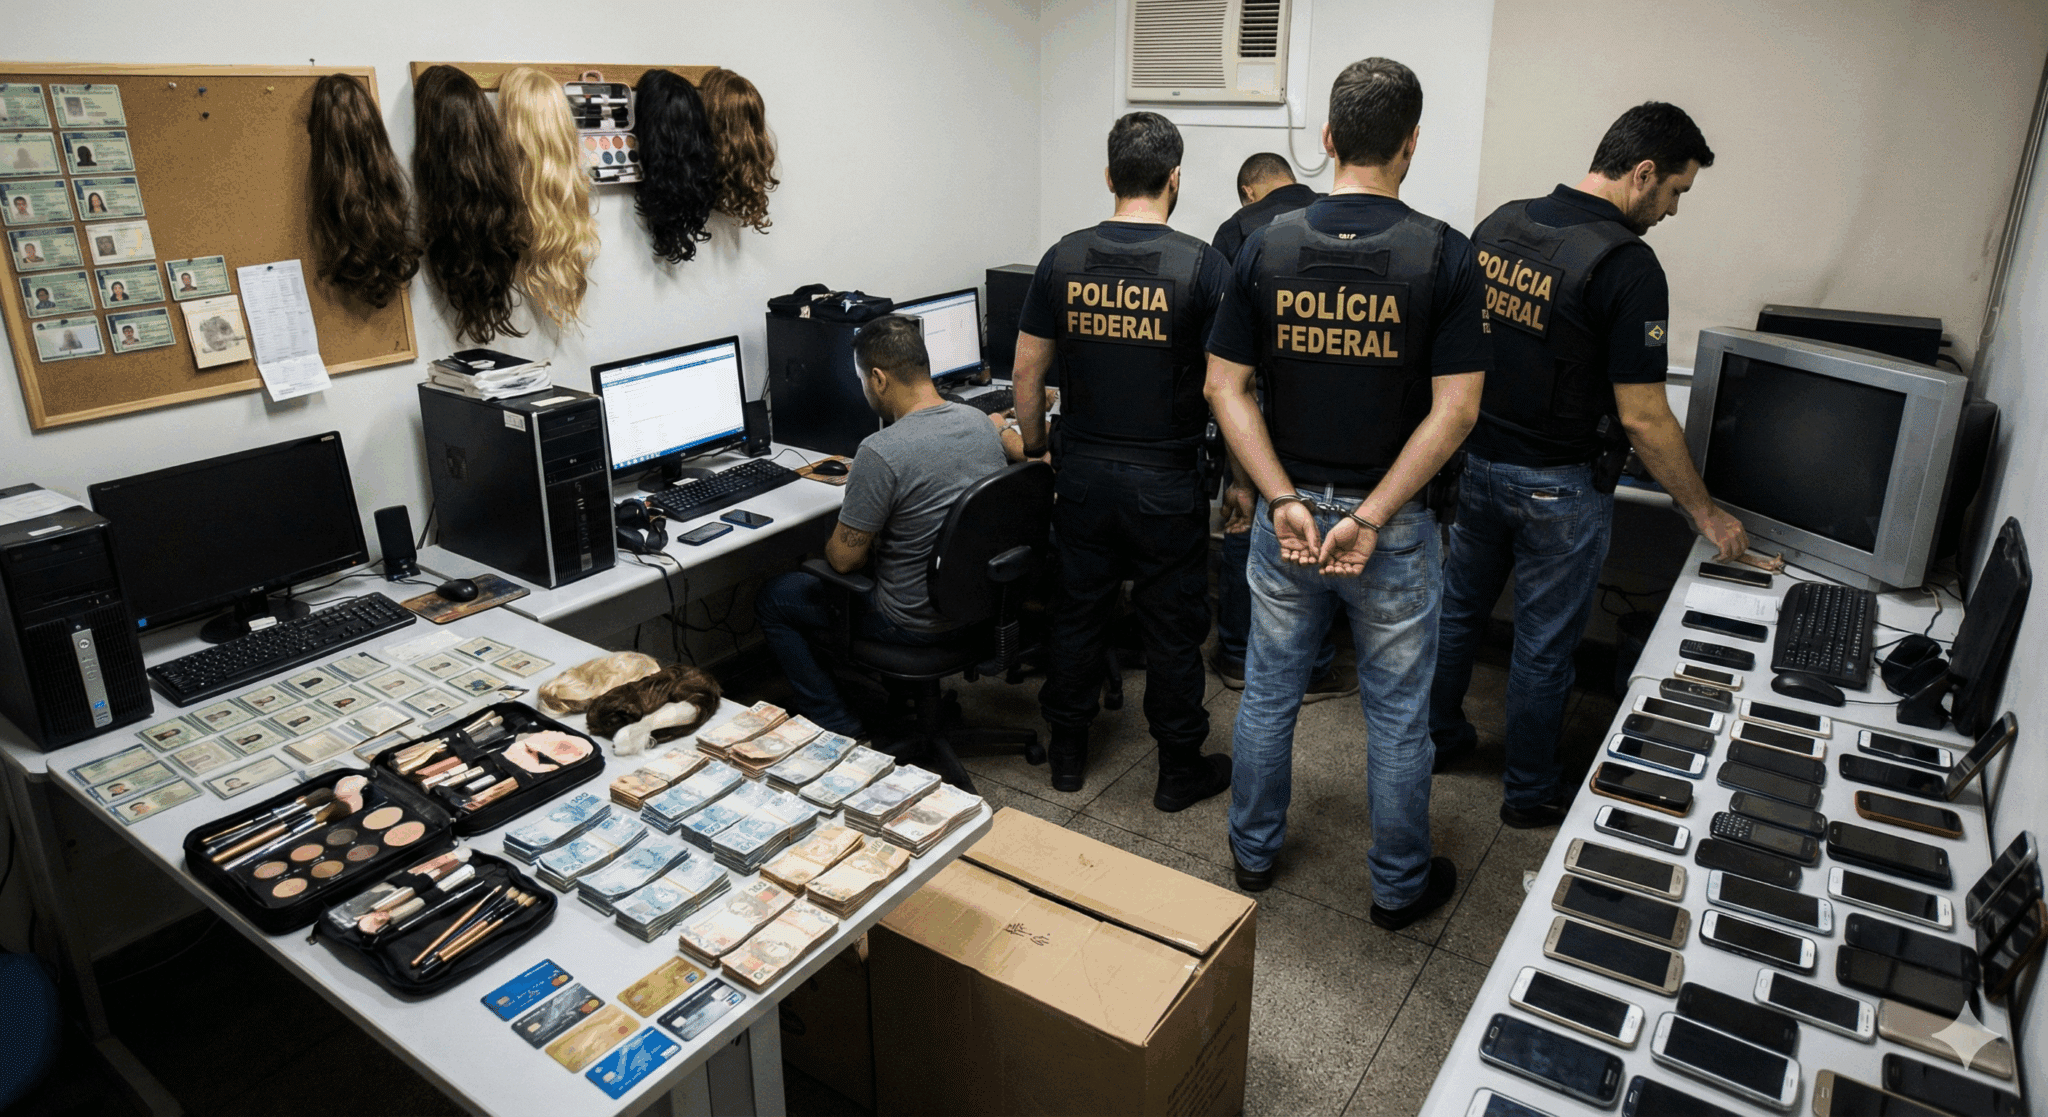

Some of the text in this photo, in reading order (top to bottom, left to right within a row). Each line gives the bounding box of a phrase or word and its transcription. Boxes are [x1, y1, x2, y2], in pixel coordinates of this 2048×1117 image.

[1478, 251, 1552, 301] POLÍCIA
[1067, 279, 1169, 312] POLÍCIA
[1276, 286, 1401, 323] POLÍCIA
[1485, 284, 1544, 331] DERAL
[1067, 311, 1167, 341] FEDERAL
[1277, 323, 1399, 358] FEDERAL
